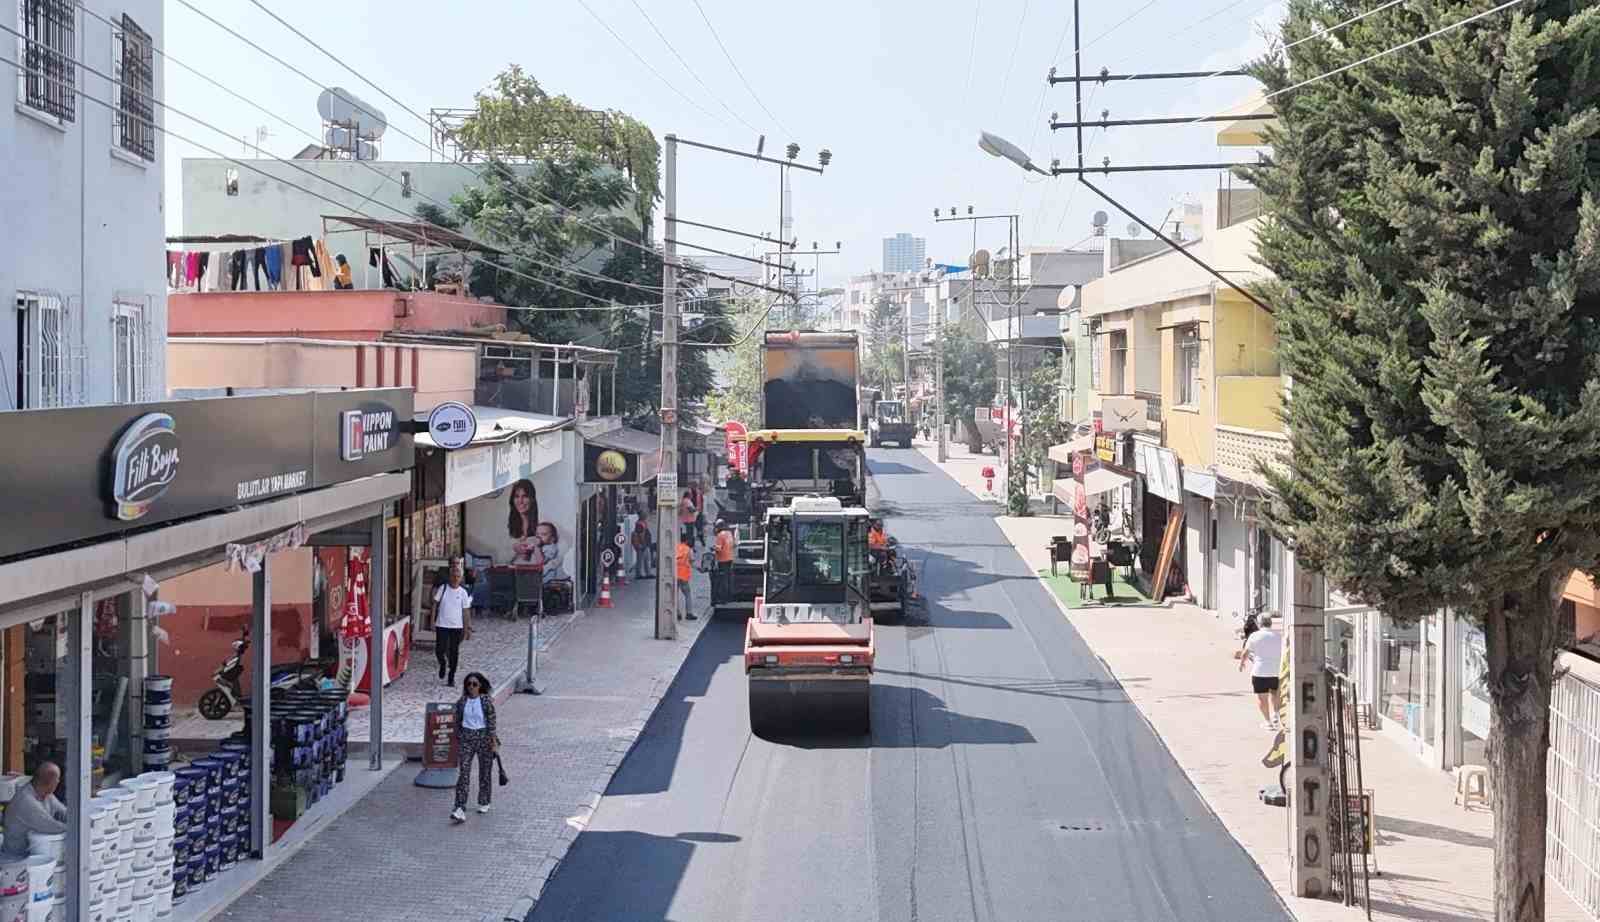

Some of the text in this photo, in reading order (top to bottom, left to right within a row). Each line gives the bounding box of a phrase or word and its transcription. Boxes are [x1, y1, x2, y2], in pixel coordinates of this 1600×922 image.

[363, 432, 388, 453] PAINT
[127, 443, 179, 491] Filli Boya
[237, 478, 269, 499] BULUTLAR
[284, 470, 307, 488] MARKET
